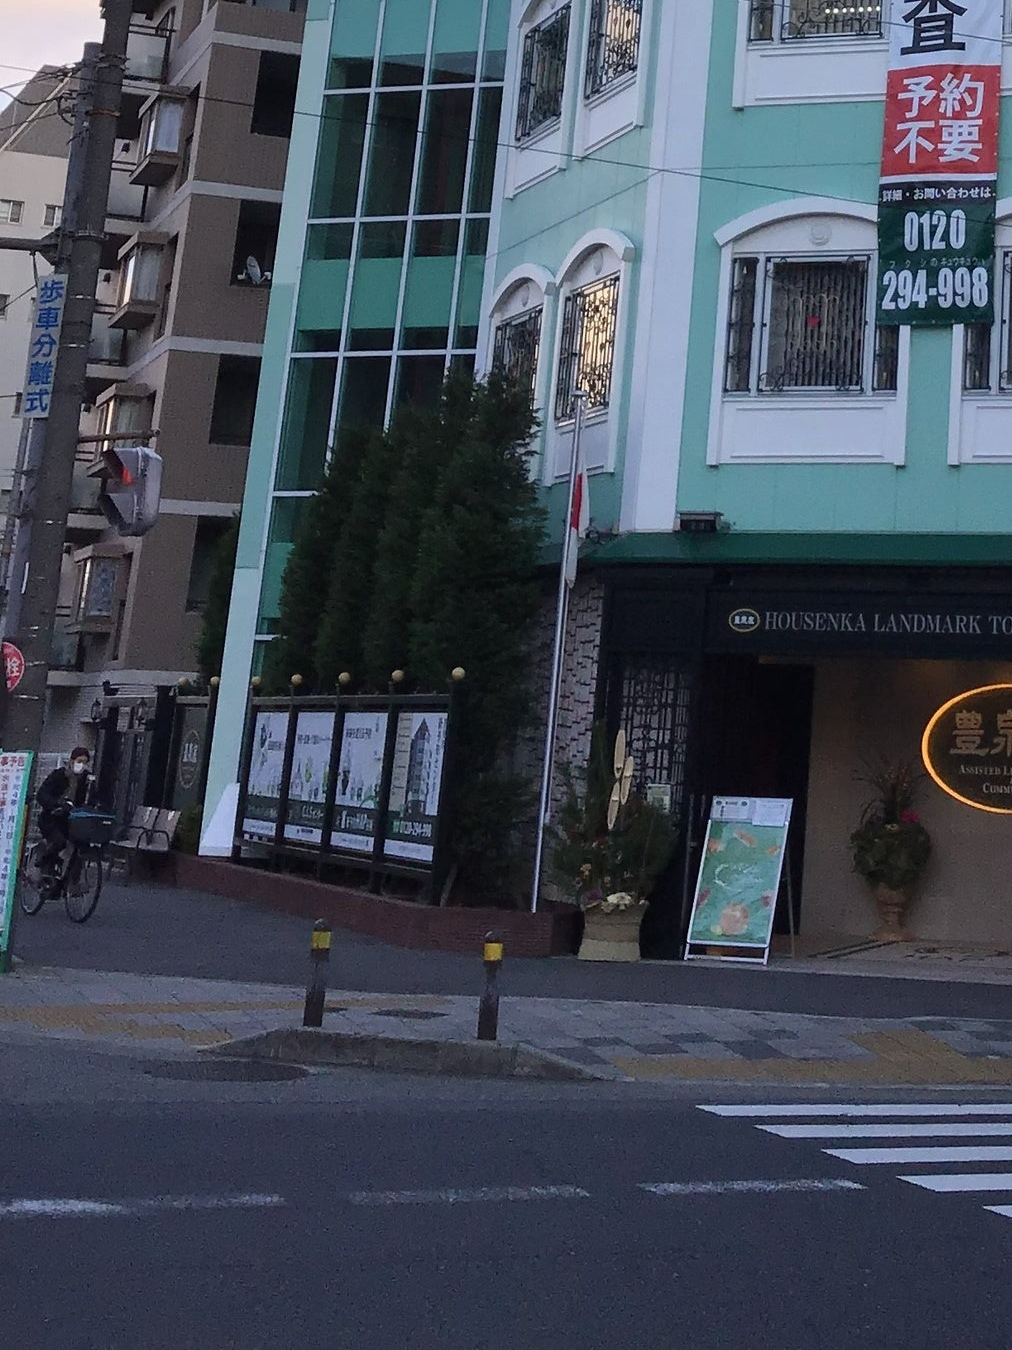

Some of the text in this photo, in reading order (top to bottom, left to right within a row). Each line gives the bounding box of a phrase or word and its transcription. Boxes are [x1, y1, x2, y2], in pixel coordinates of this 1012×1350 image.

[897, 73, 985, 119] 予約
[893, 118, 983, 164] 不要
[904, 210, 966, 251] 0120
[882, 267, 988, 310] 294-998
[24, 279, 67, 414] 歩車分離式
[765, 611, 866, 632] HOUSENKA
[874, 613, 982, 634] LANDMARK
